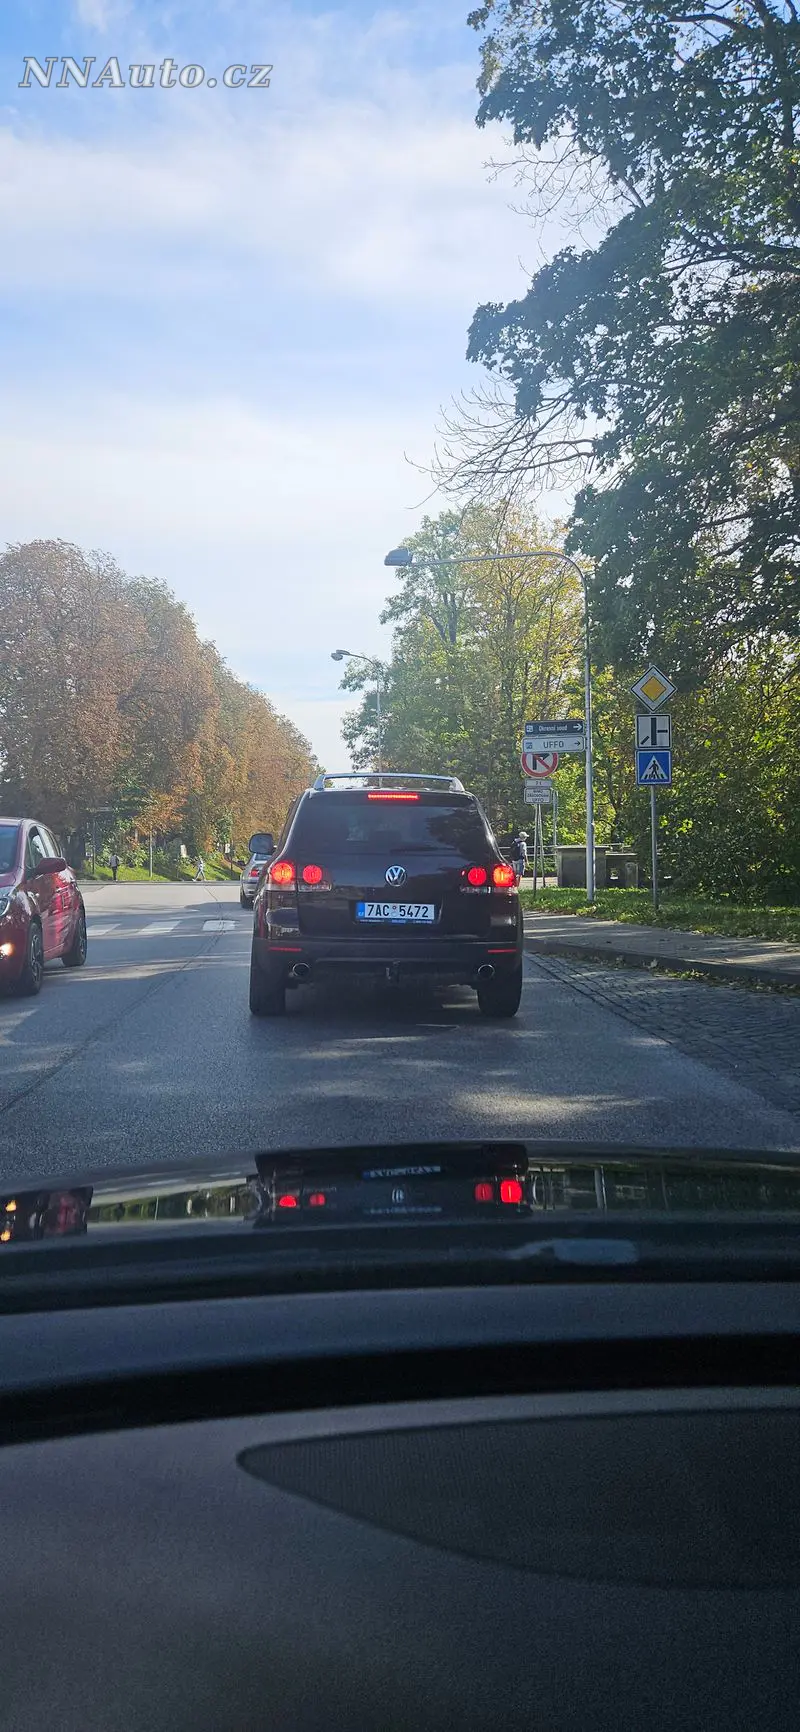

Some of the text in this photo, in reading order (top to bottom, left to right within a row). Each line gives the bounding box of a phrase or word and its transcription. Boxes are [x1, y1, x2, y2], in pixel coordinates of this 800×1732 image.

[543, 740, 564, 749] UFFO
[367, 904, 429, 918] 7AC 5472
